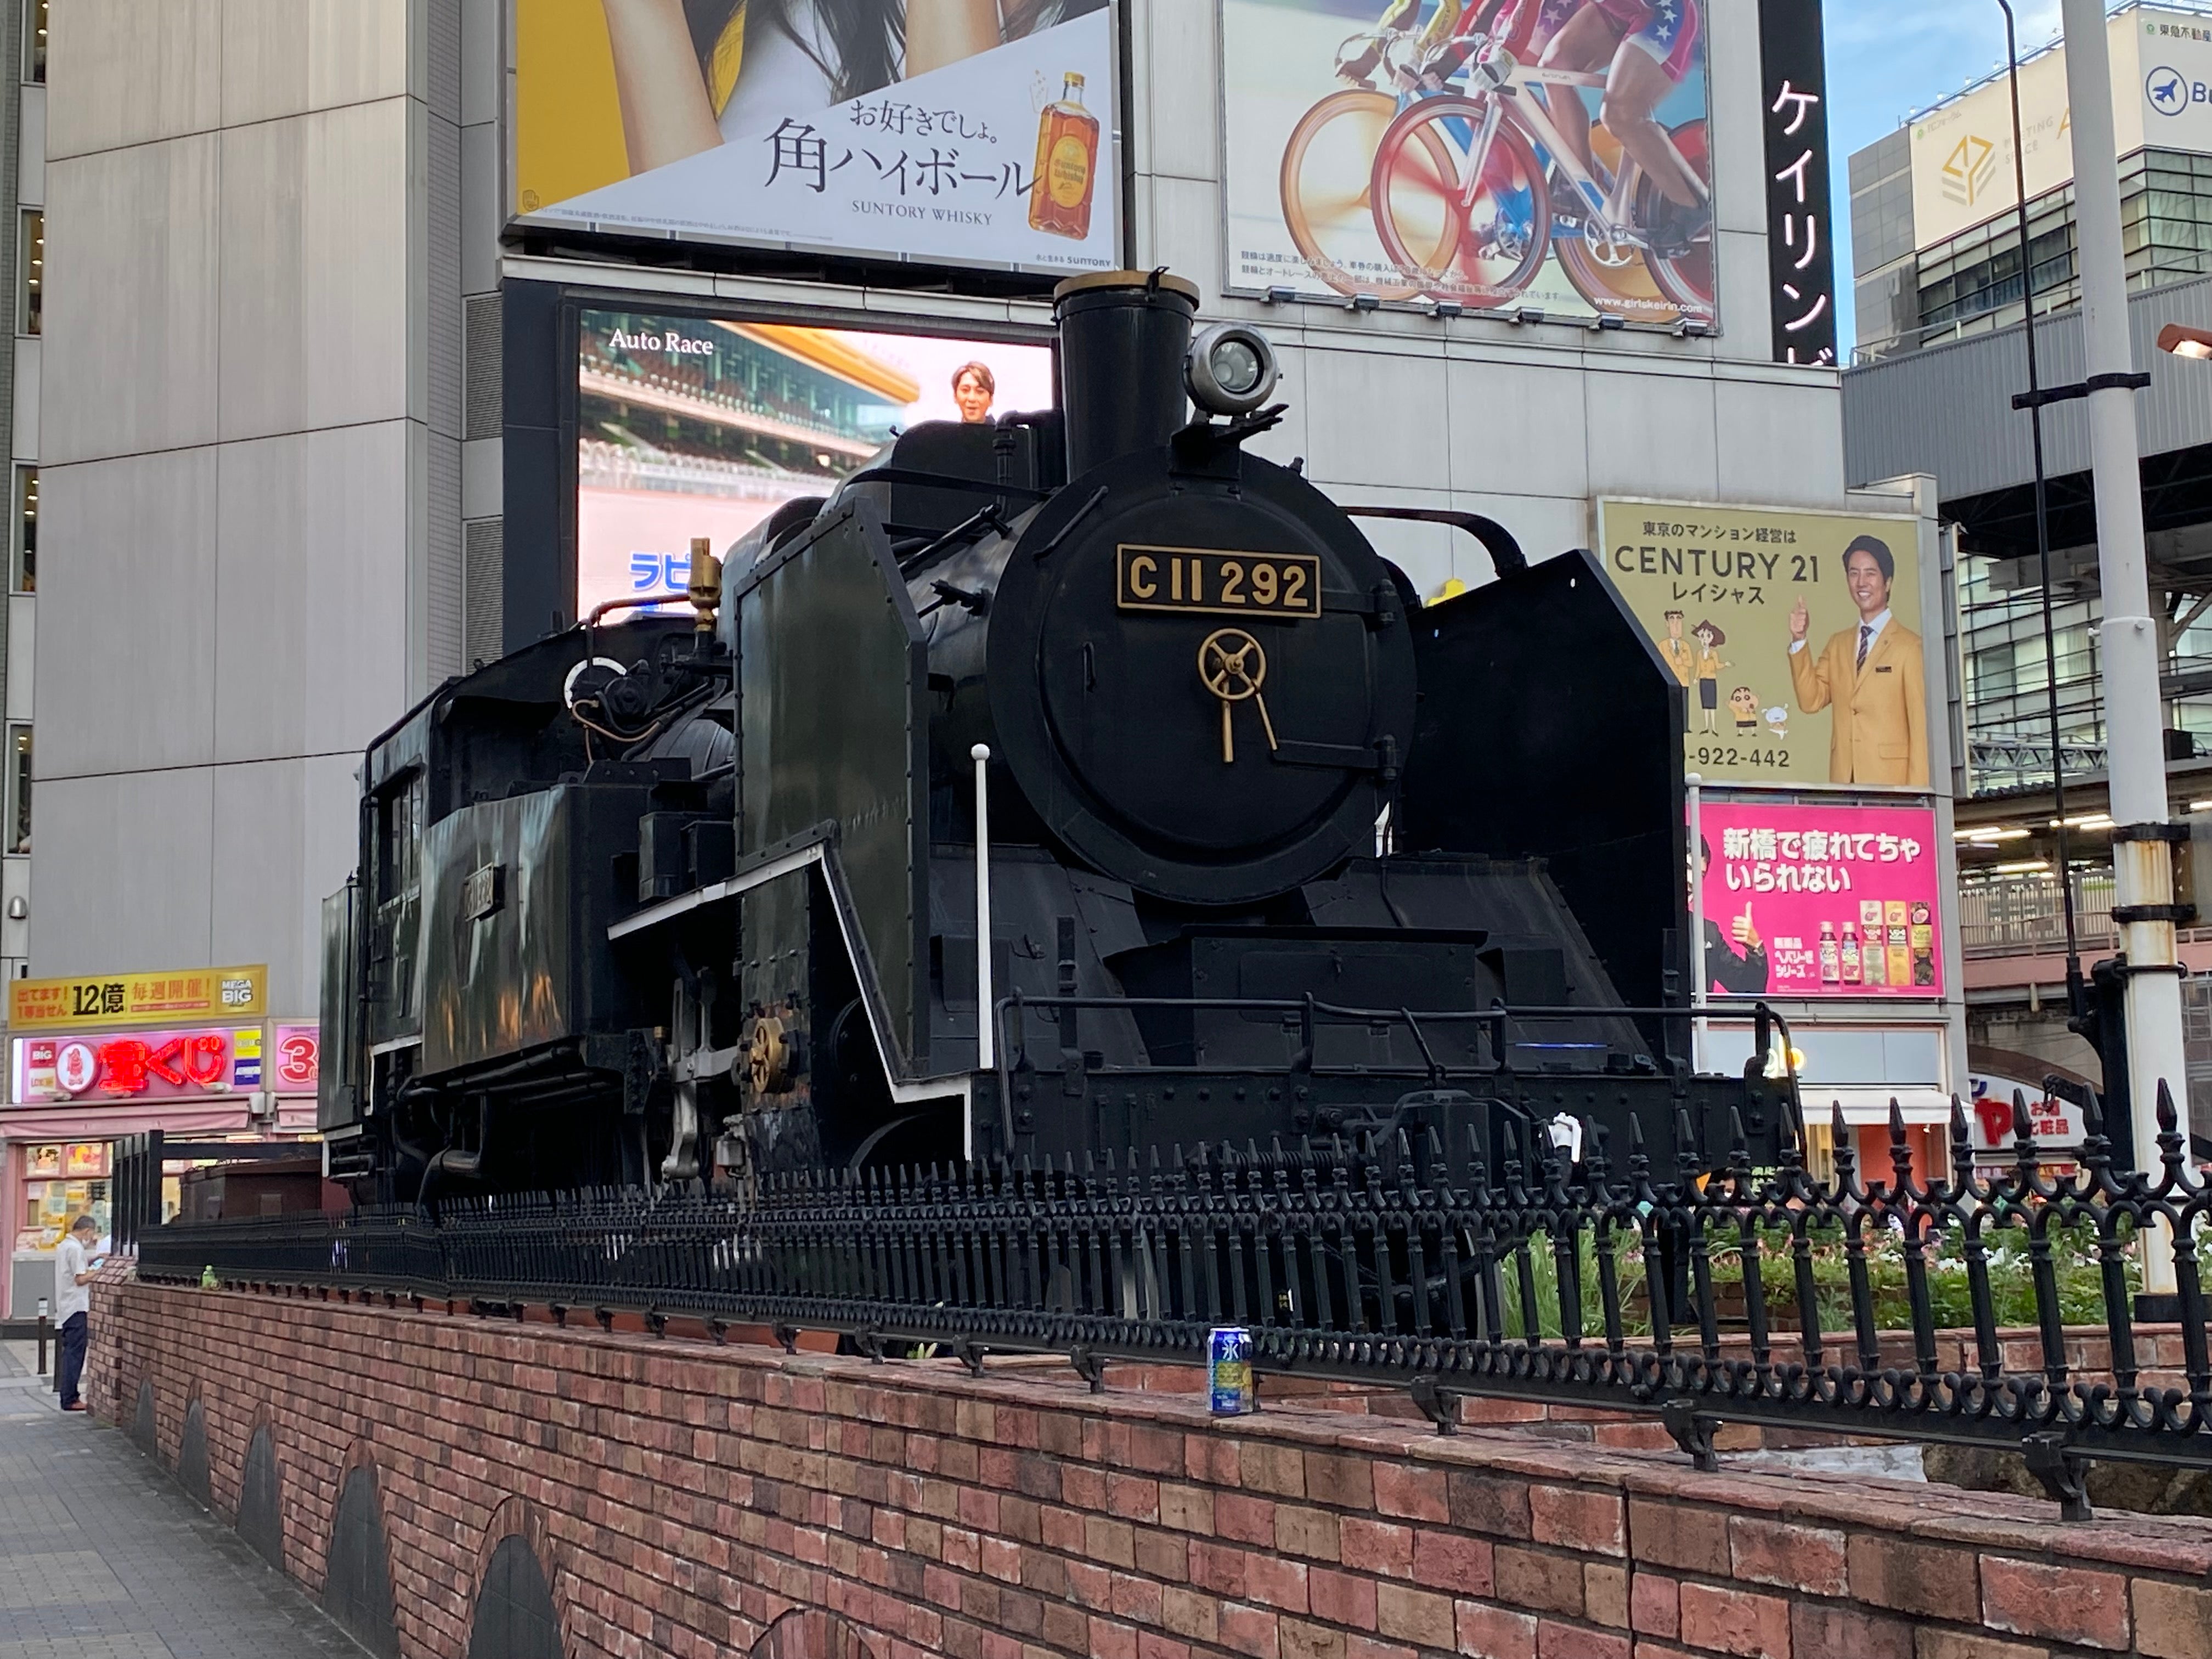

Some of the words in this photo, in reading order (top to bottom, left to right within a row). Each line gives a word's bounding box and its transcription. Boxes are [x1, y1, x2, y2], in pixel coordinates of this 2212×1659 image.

[2192, 81, 2212, 104] B
[849, 99, 997, 144] お好きでしょ。
[763, 117, 1042, 199] 角ハイボール
[851, 200, 926, 219] SUNTORY
[932, 208, 992, 225] WHISKY
[1067, 256, 1111, 268] SUNTORY
[1593, 297, 1703, 313] www.girlskeirin.com
[608, 327, 661, 352] Auto
[665, 331, 714, 356] Race
[1643, 521, 1797, 544] 東京のマンション経営は
[1615, 545, 1780, 581] CENTURY
[1791, 554, 1820, 583] 21
[1221, 561, 1308, 607] 292
[1672, 582, 1765, 606] レイシャス
[1723, 827, 1921, 864] 新橋で疲れてちゃ
[1725, 863, 1852, 893] いられない
[221, 979, 252, 989] MEGA
[221, 989, 253, 1003] BIG
[72, 983, 125, 1015] 12億
[98, 1036, 227, 1092] 宝くじ
